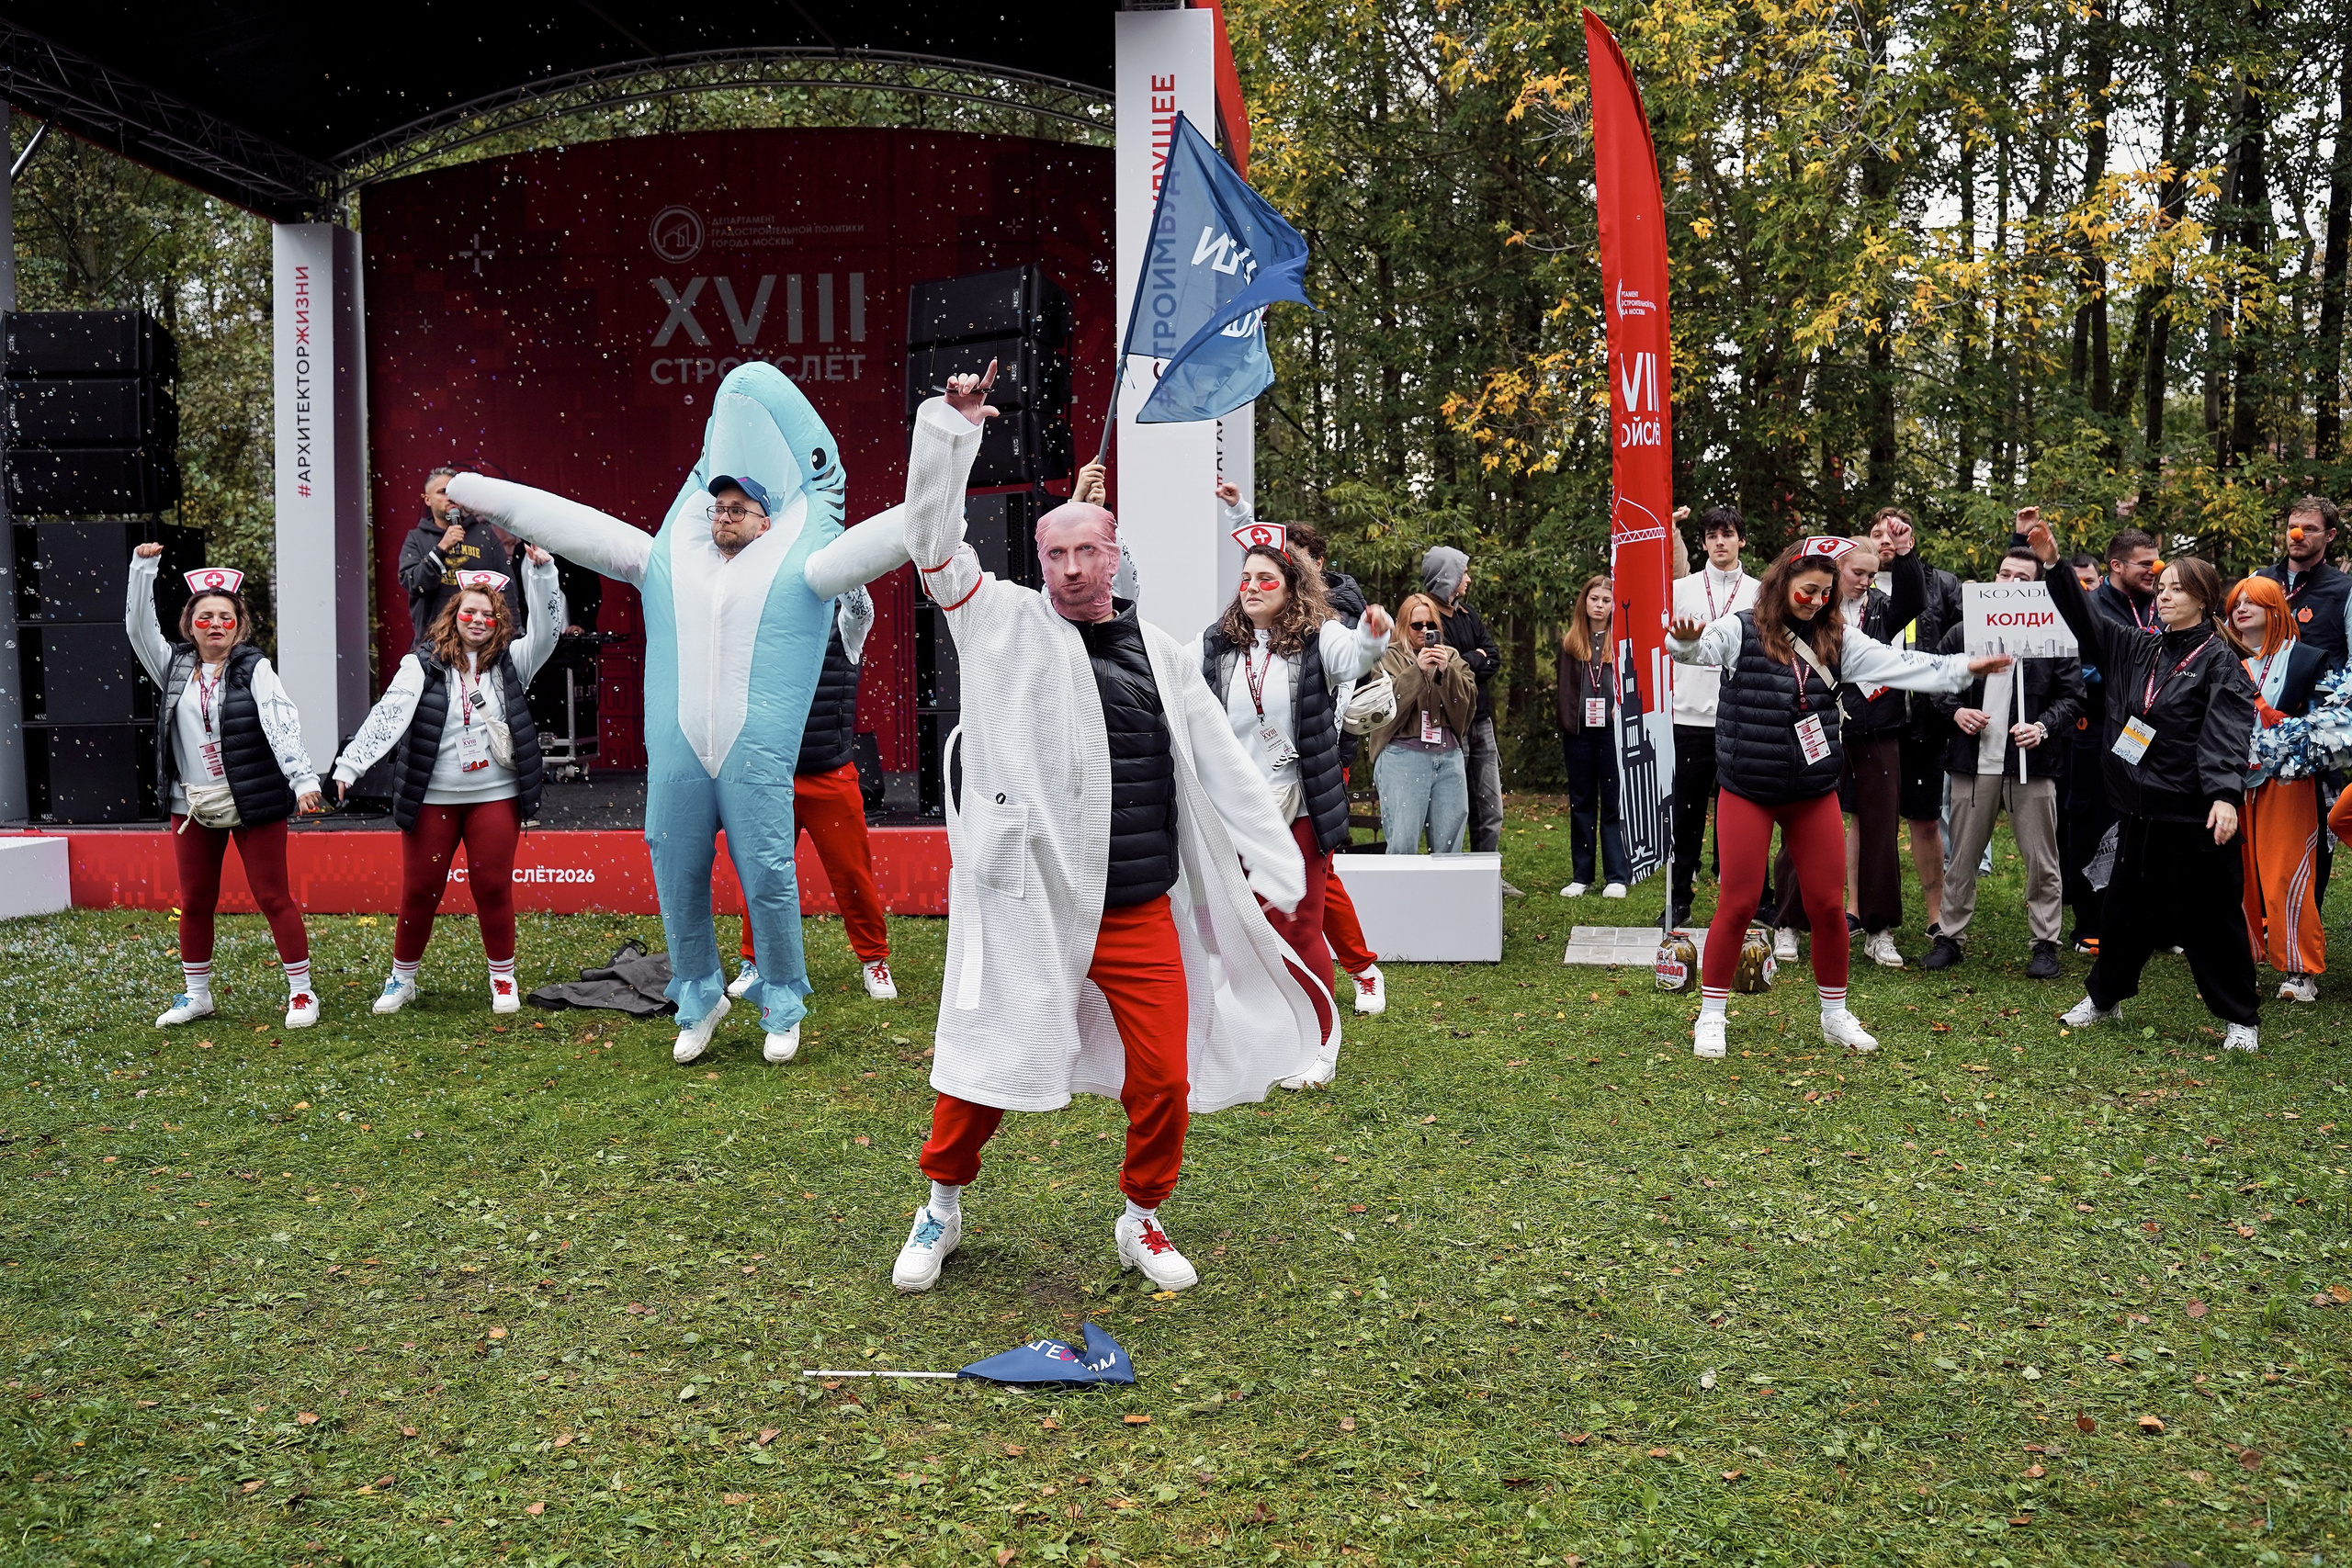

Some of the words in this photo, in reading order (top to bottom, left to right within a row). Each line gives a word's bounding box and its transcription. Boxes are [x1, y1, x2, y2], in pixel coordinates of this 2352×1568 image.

[711, 215, 775, 226] ДЕПАРТАМЕНТ
[711, 225, 812, 237] ГРАДОСТРОИТЕЛЬНОЙ
[815, 224, 865, 233] ПОЛИТИКИ
[711, 239, 750, 248] ГОРОДА
[752, 237, 794, 246] МОСКВЫ
[650, 272, 865, 347] XVIII
[650, 347, 866, 385] СТРОСЛЁТ
[295, 266, 311, 498] #АРХИТЕКТОРЖИЗНИ
[1986, 612, 2053, 627] КОЛДИ
